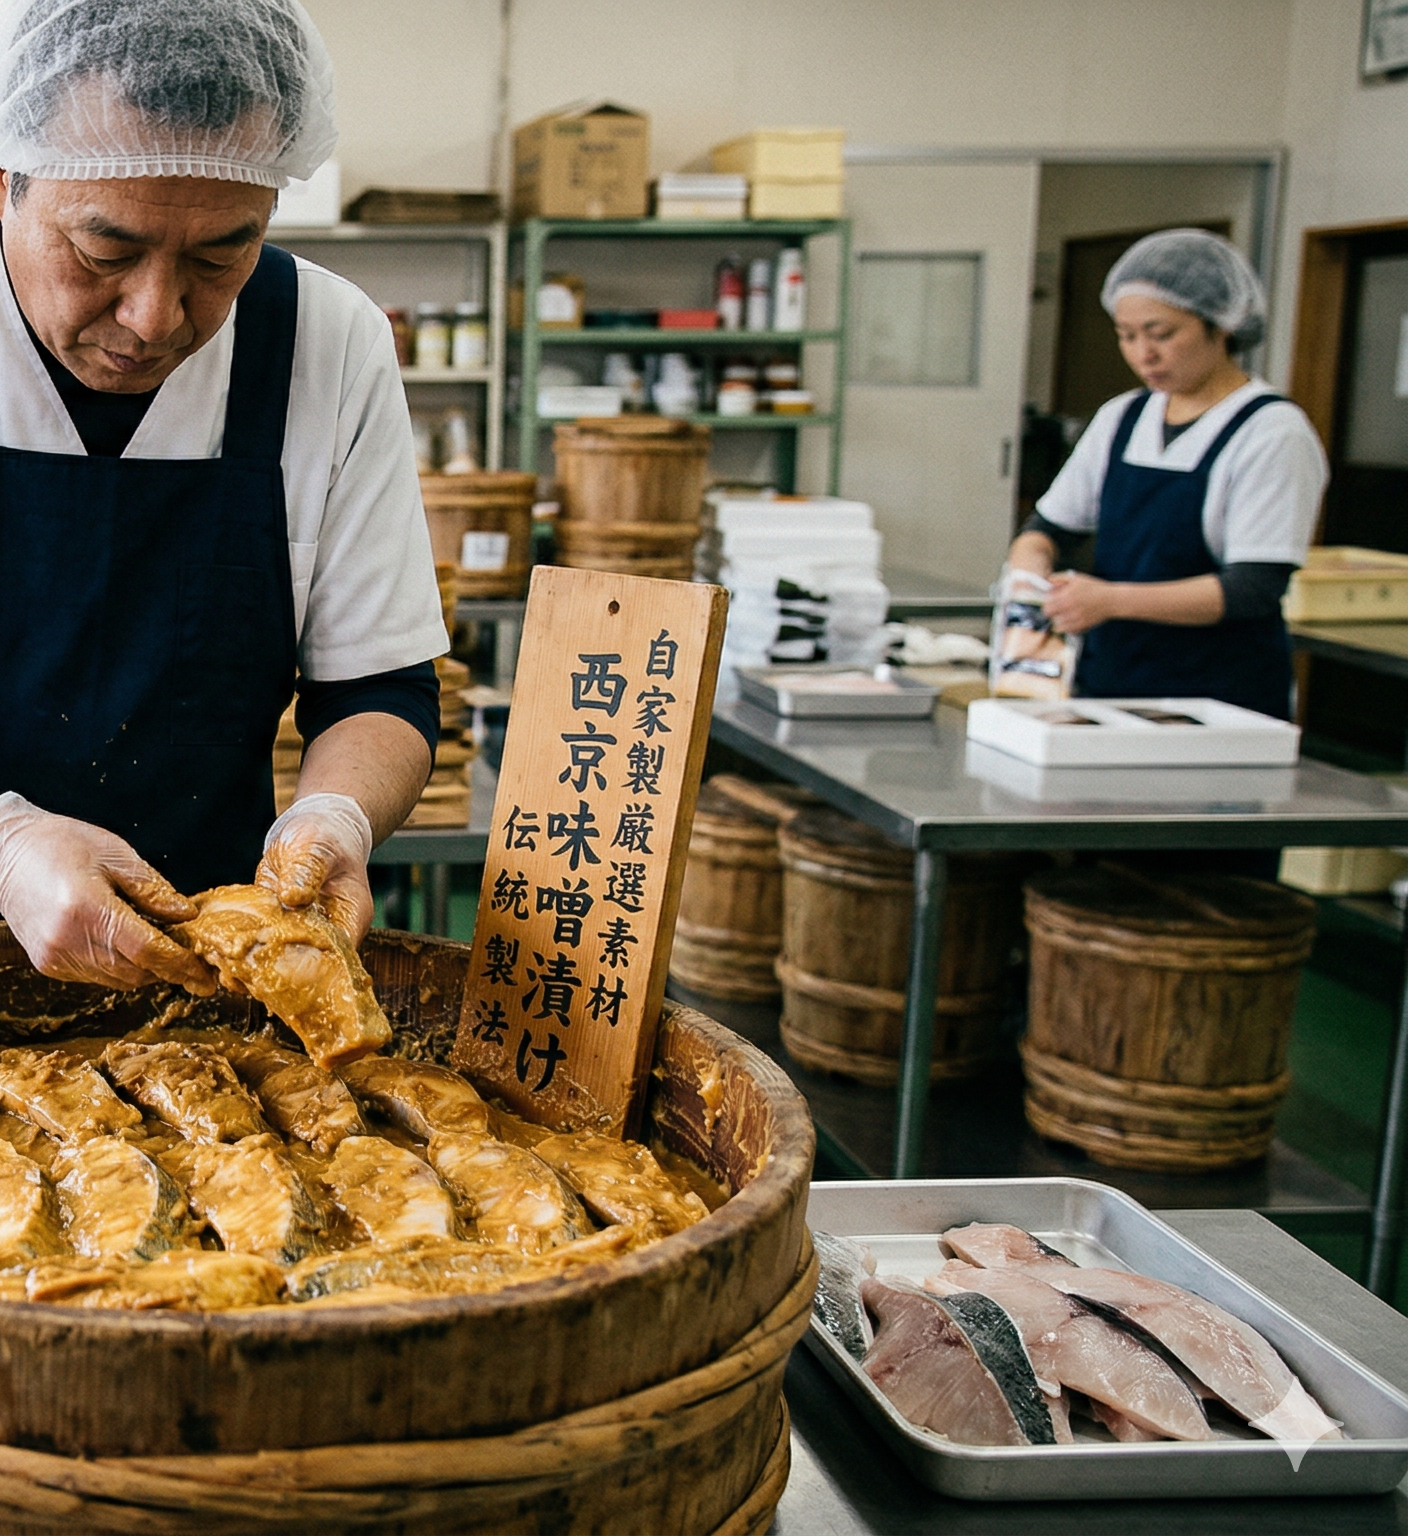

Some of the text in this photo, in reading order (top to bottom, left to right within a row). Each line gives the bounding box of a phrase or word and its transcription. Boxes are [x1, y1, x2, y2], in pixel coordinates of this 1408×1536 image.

[472, 805, 540, 1047] 伝統製法
[516, 653, 627, 1092] 西京味噌漬け
[585, 629, 679, 1027] 自家製厳選素材
